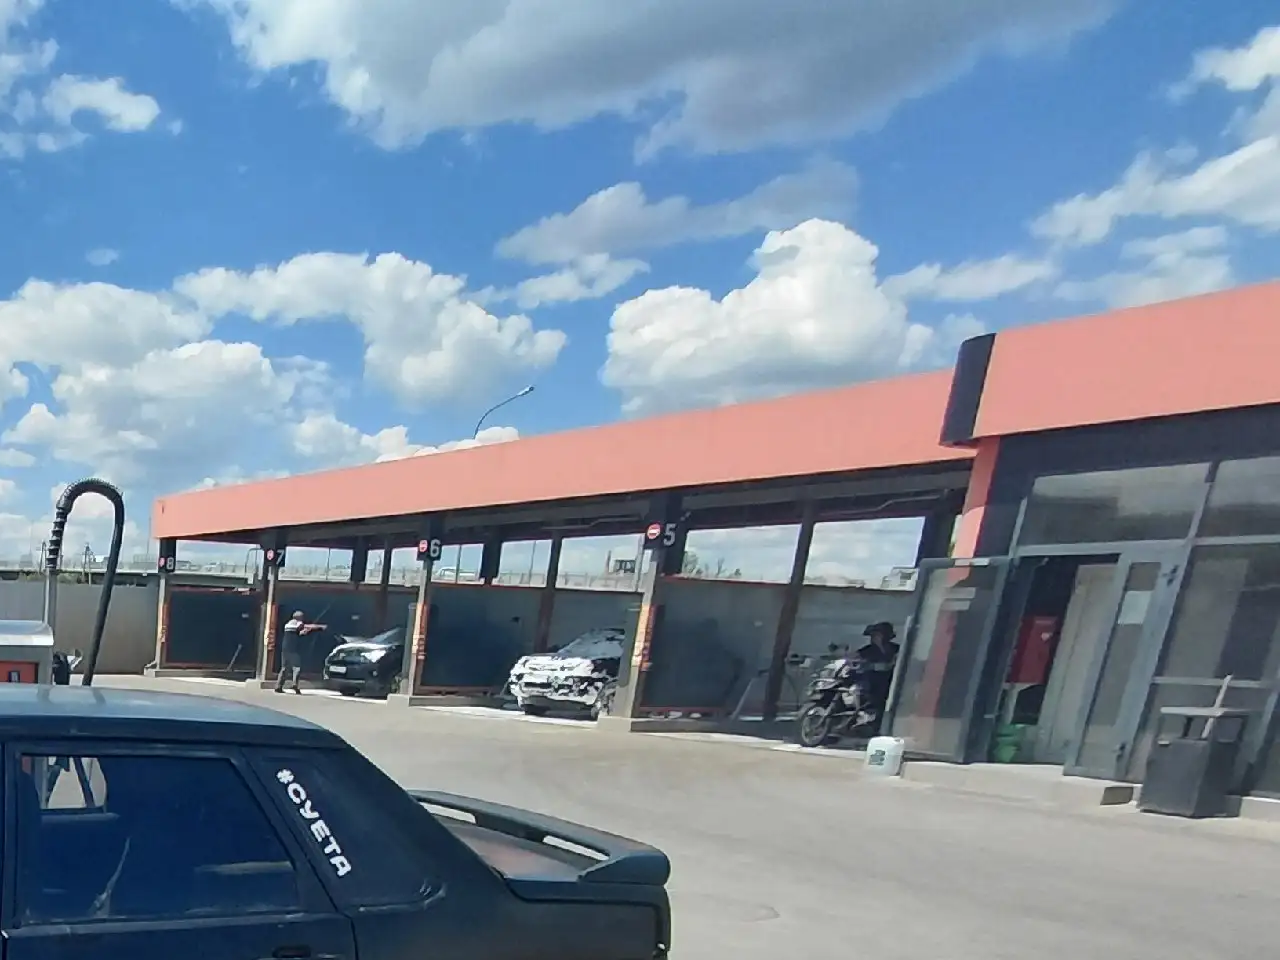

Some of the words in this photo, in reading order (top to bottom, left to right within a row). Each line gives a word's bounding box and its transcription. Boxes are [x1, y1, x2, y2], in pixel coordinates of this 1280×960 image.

[664, 523, 675, 546] 5
[276, 549, 285, 565] 7
[430, 539, 440, 558] 6
[166, 557, 175, 570] 8
